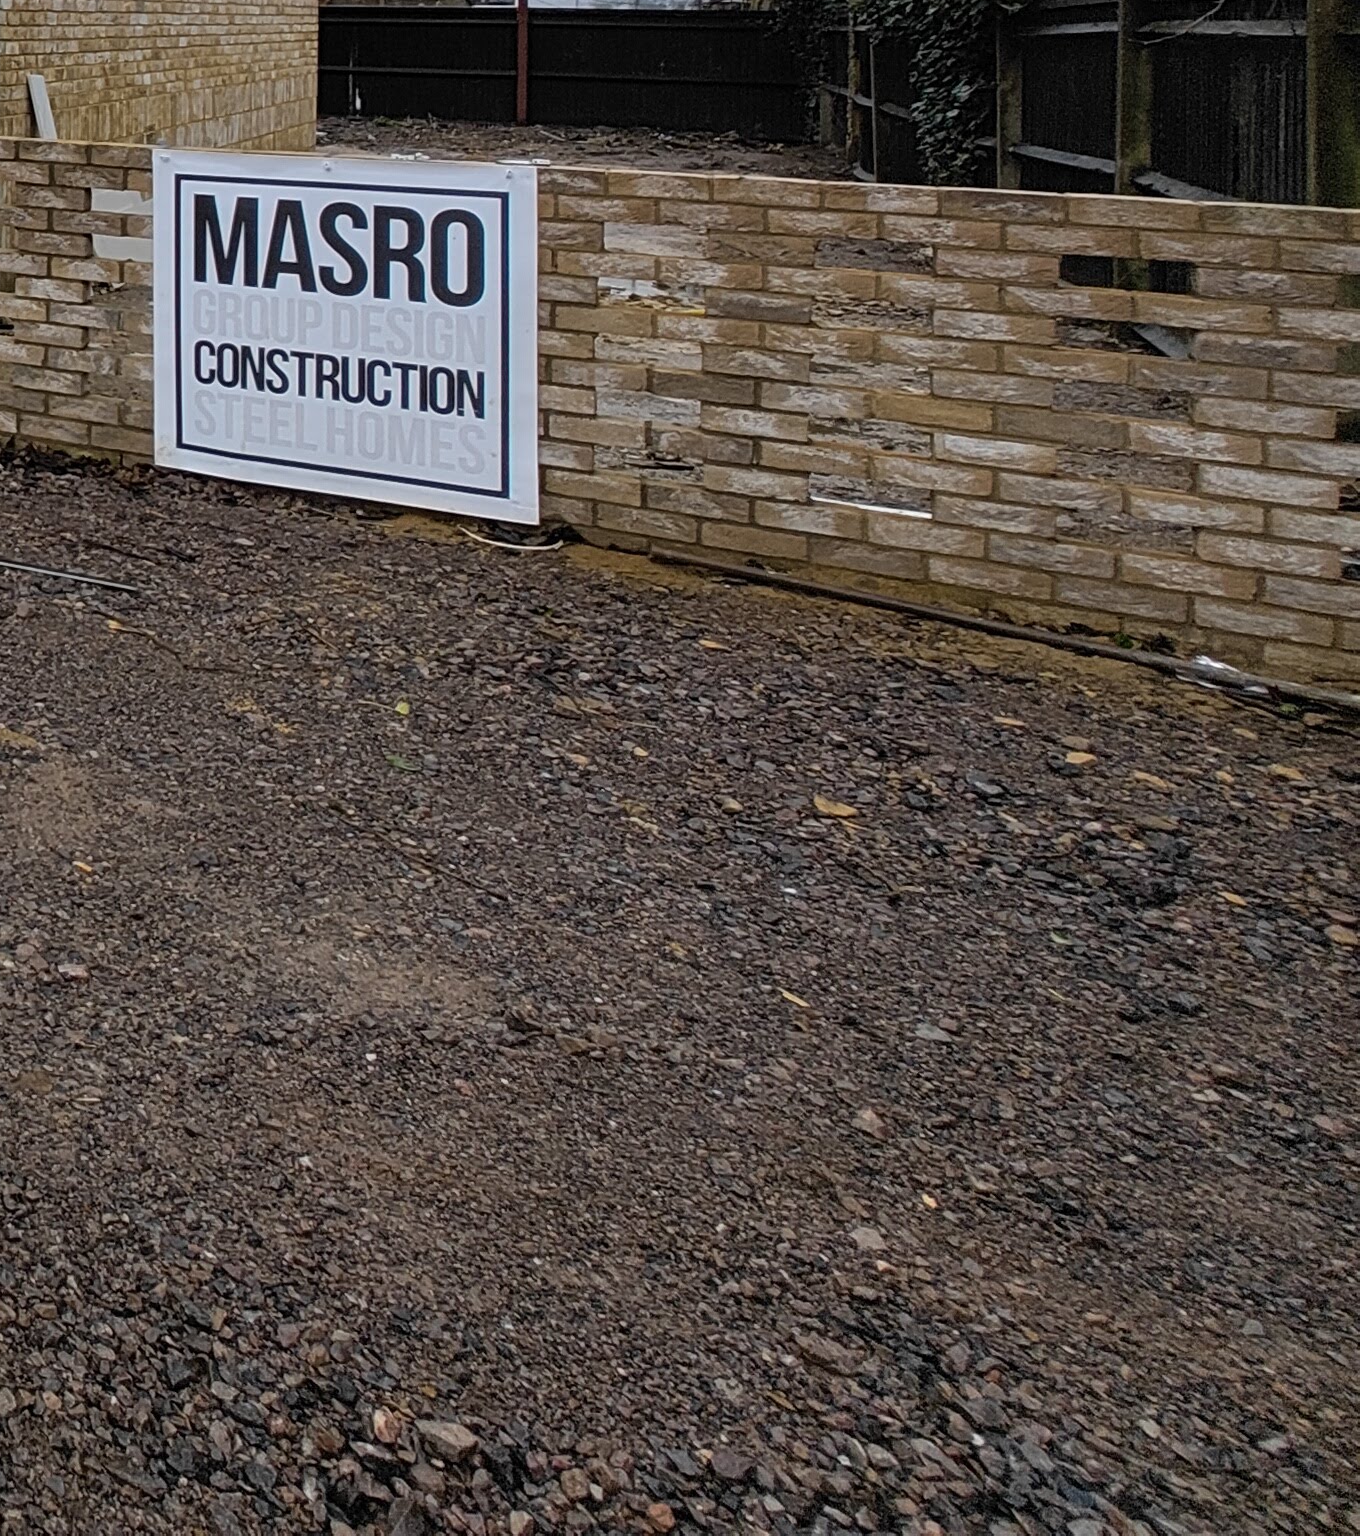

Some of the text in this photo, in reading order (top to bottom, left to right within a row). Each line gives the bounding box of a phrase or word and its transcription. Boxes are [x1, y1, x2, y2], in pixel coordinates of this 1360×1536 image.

[193, 193, 485, 307] MASRO
[192, 289, 486, 364] GROUP DESIGN
[193, 340, 486, 419] CONSTRUCTION
[194, 390, 486, 474] STEEL HOMES
